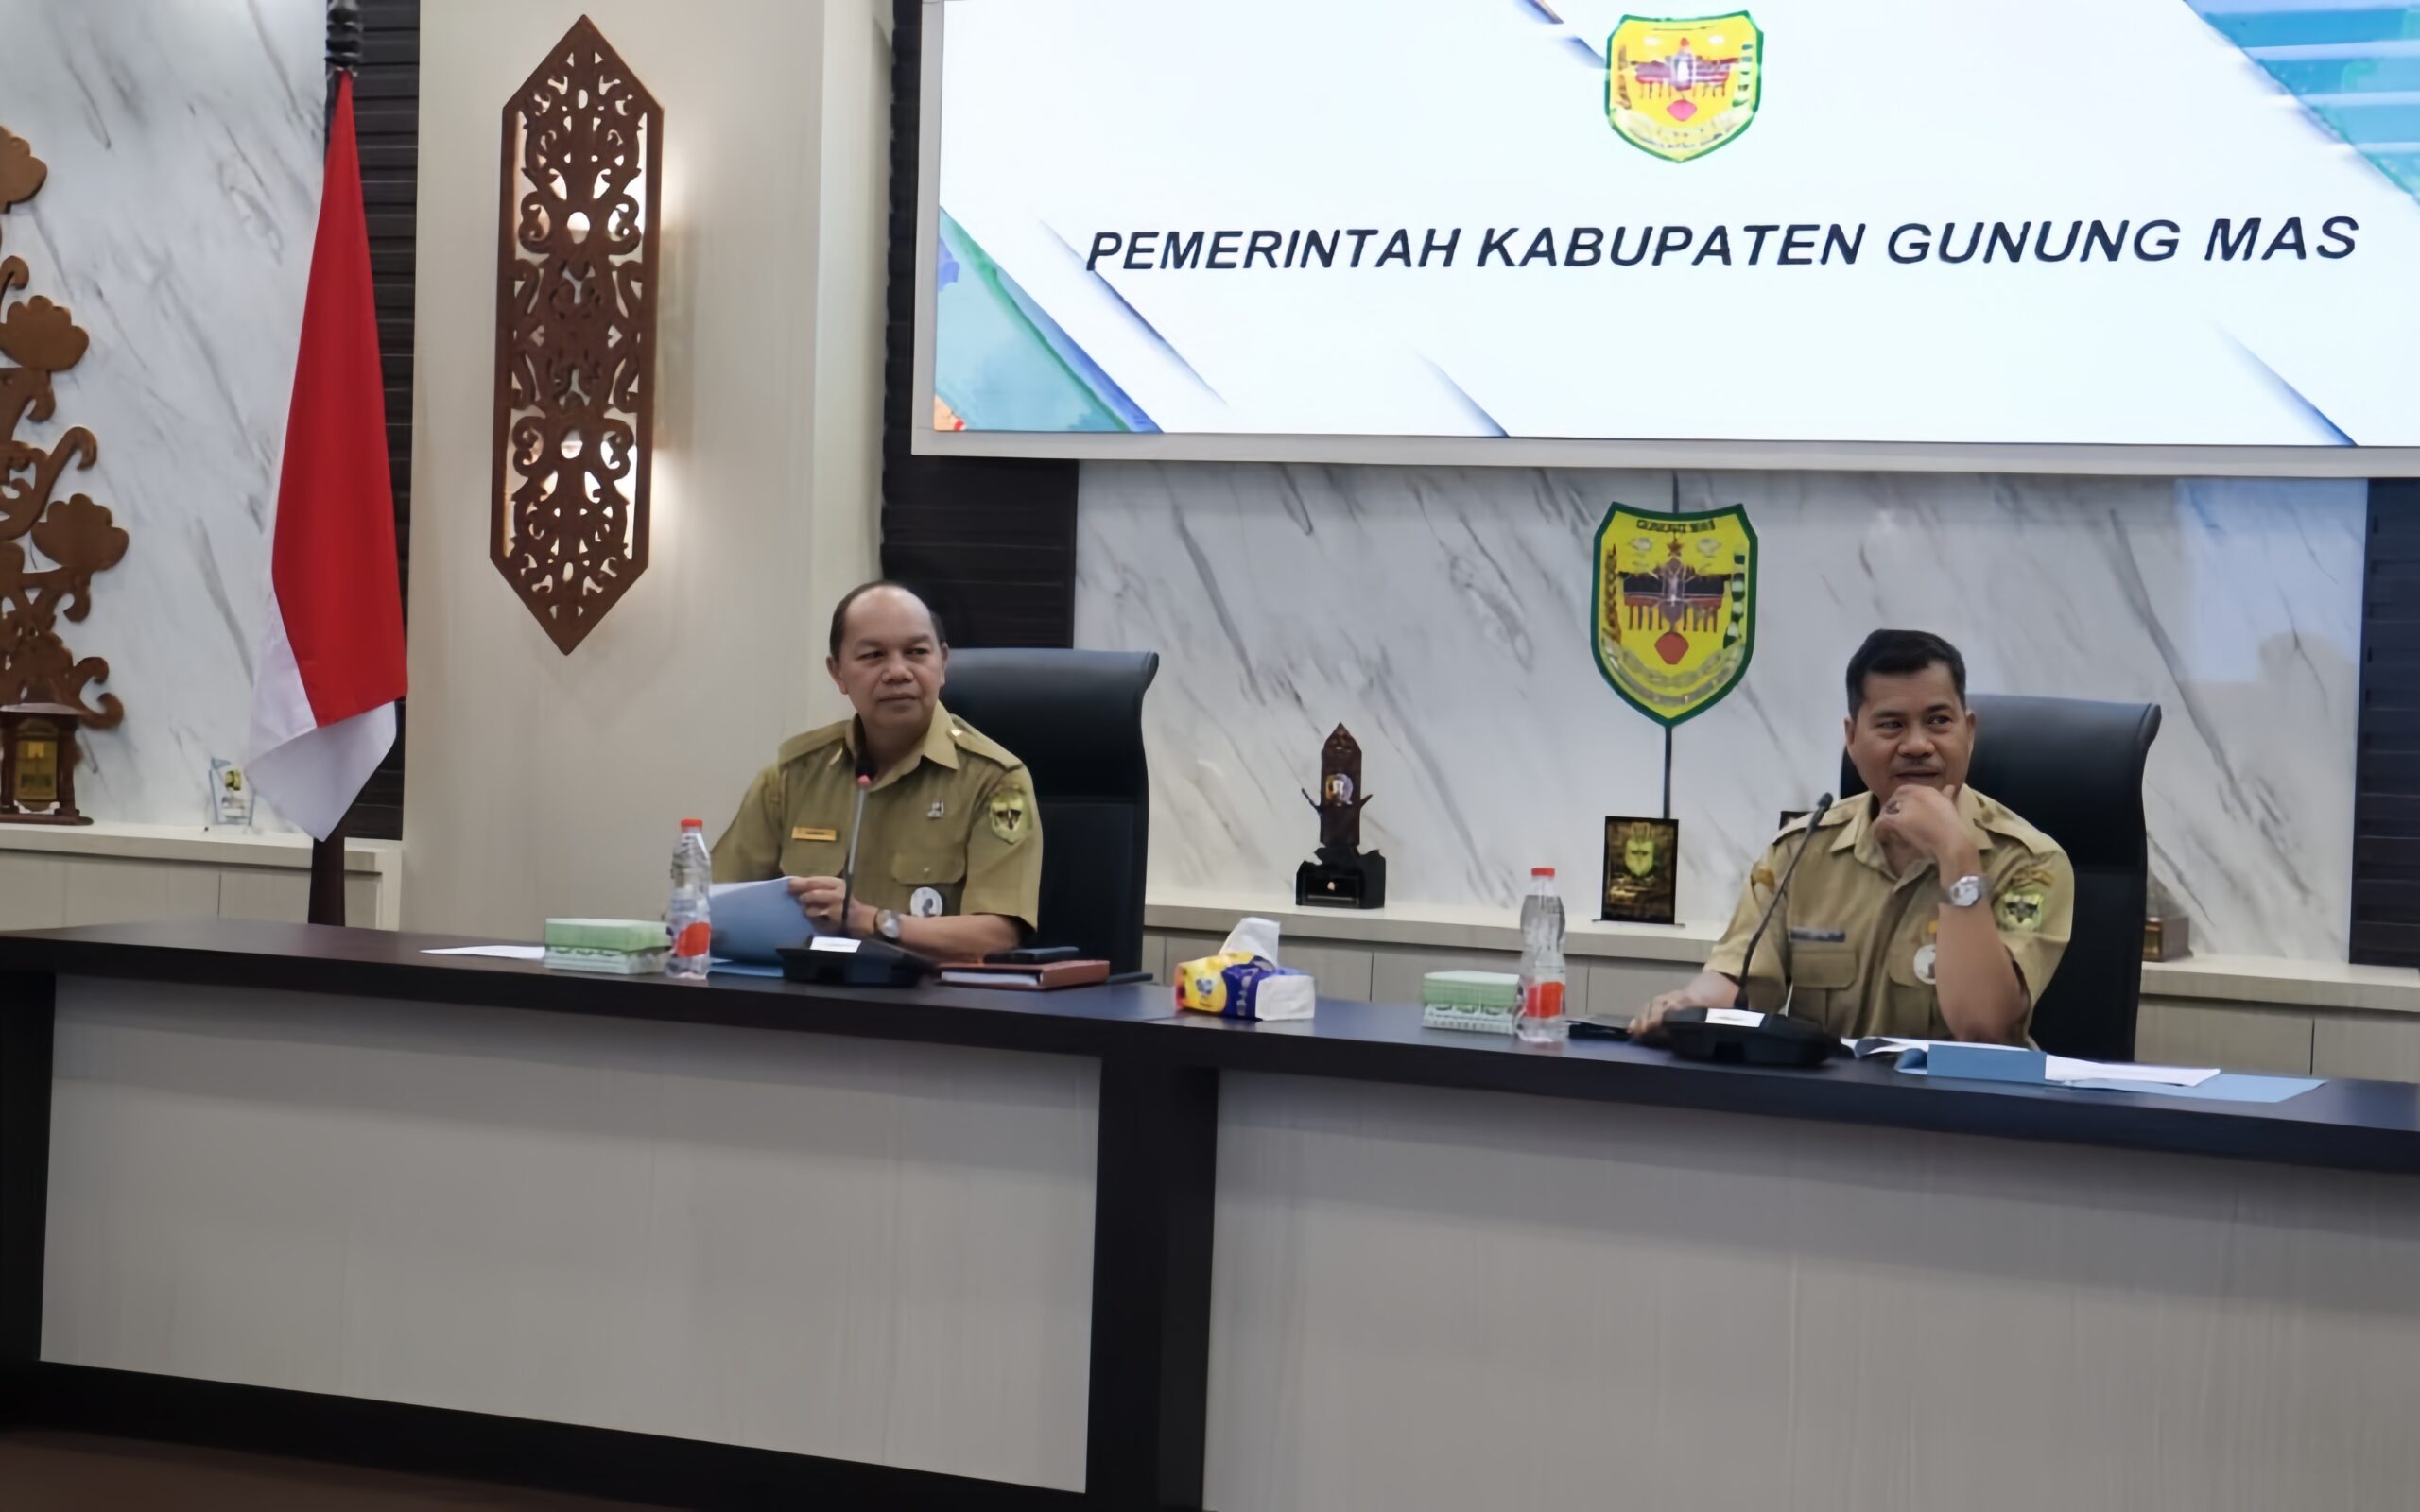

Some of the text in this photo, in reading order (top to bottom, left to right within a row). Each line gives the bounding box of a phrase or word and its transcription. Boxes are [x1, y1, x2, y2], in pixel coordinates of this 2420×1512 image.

[1086, 215, 2360, 272] PEMERINTAH KABUPATEN GUNUNG MAS
